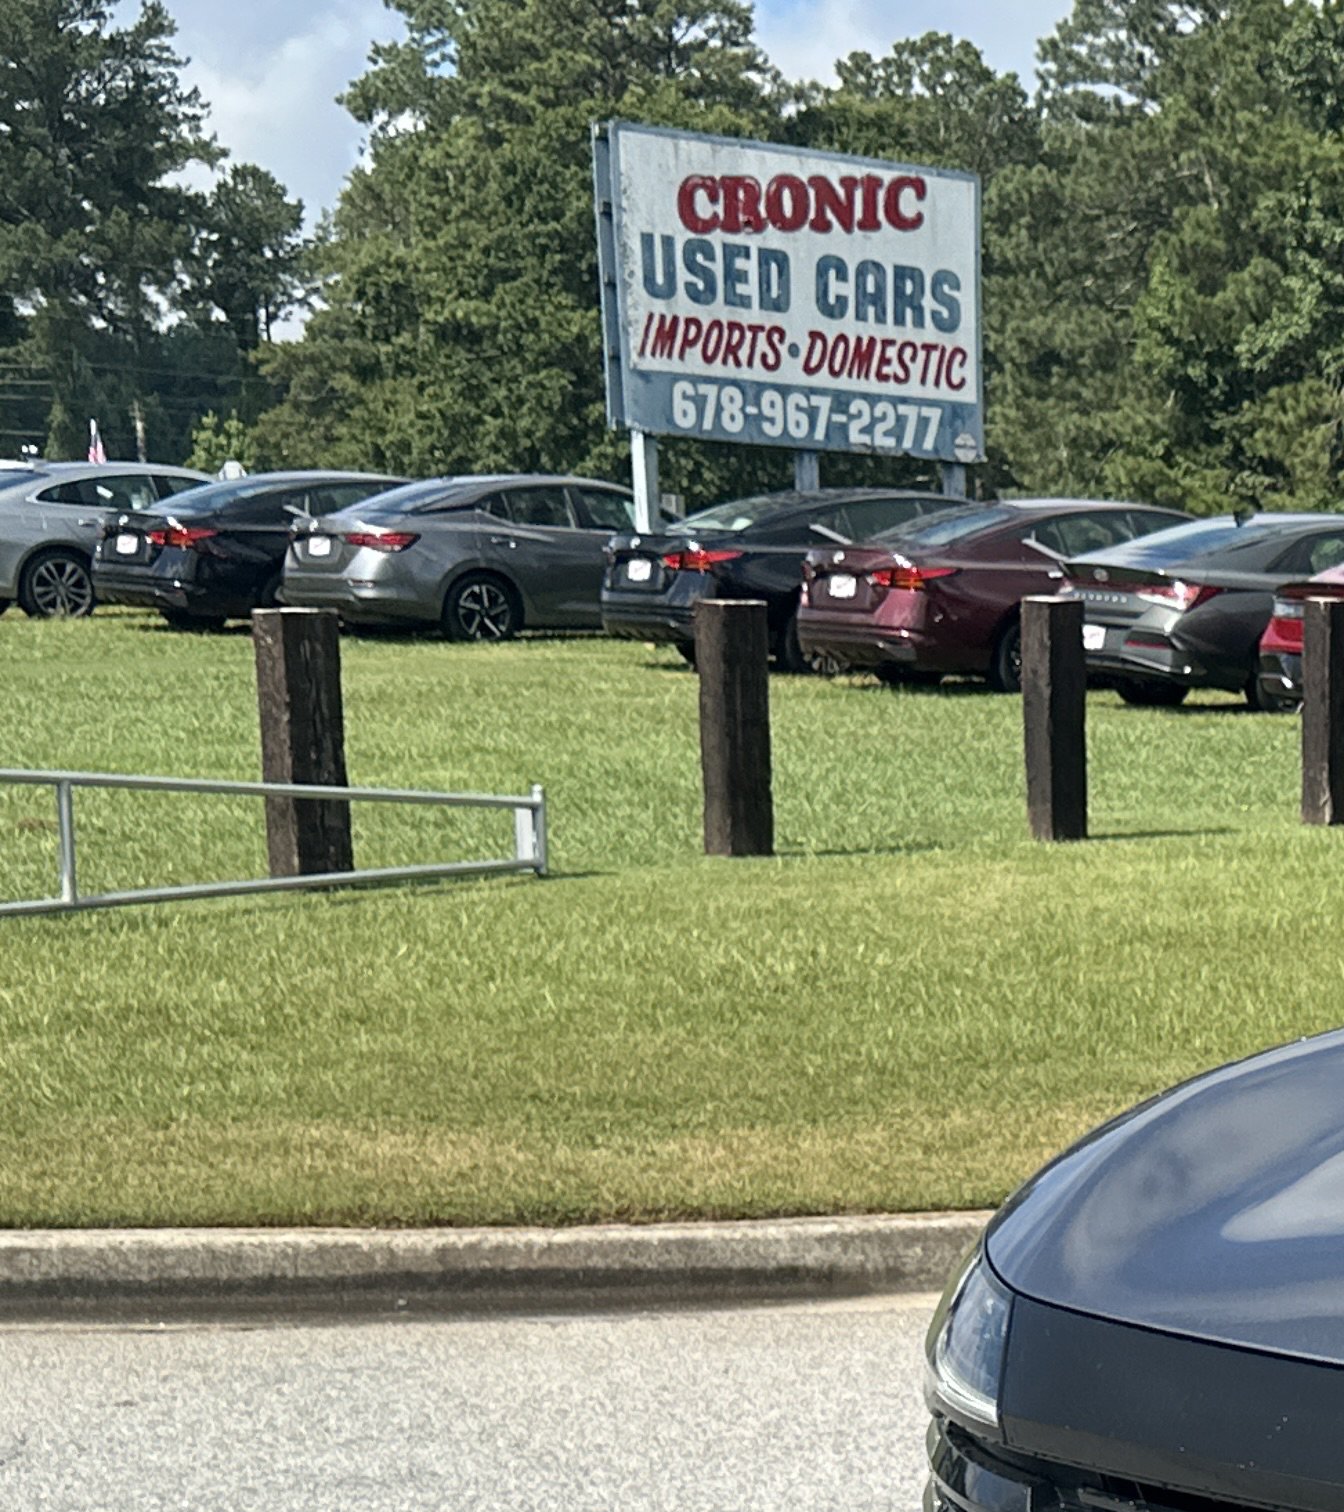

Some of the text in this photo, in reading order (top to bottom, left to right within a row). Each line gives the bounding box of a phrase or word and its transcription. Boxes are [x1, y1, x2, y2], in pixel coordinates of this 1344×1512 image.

[677, 173, 928, 235] CRONIC
[639, 231, 962, 334] USED CARS
[638, 311, 968, 391] IMPORTS DOMESTIC
[671, 380, 943, 452] 678-967-2277
